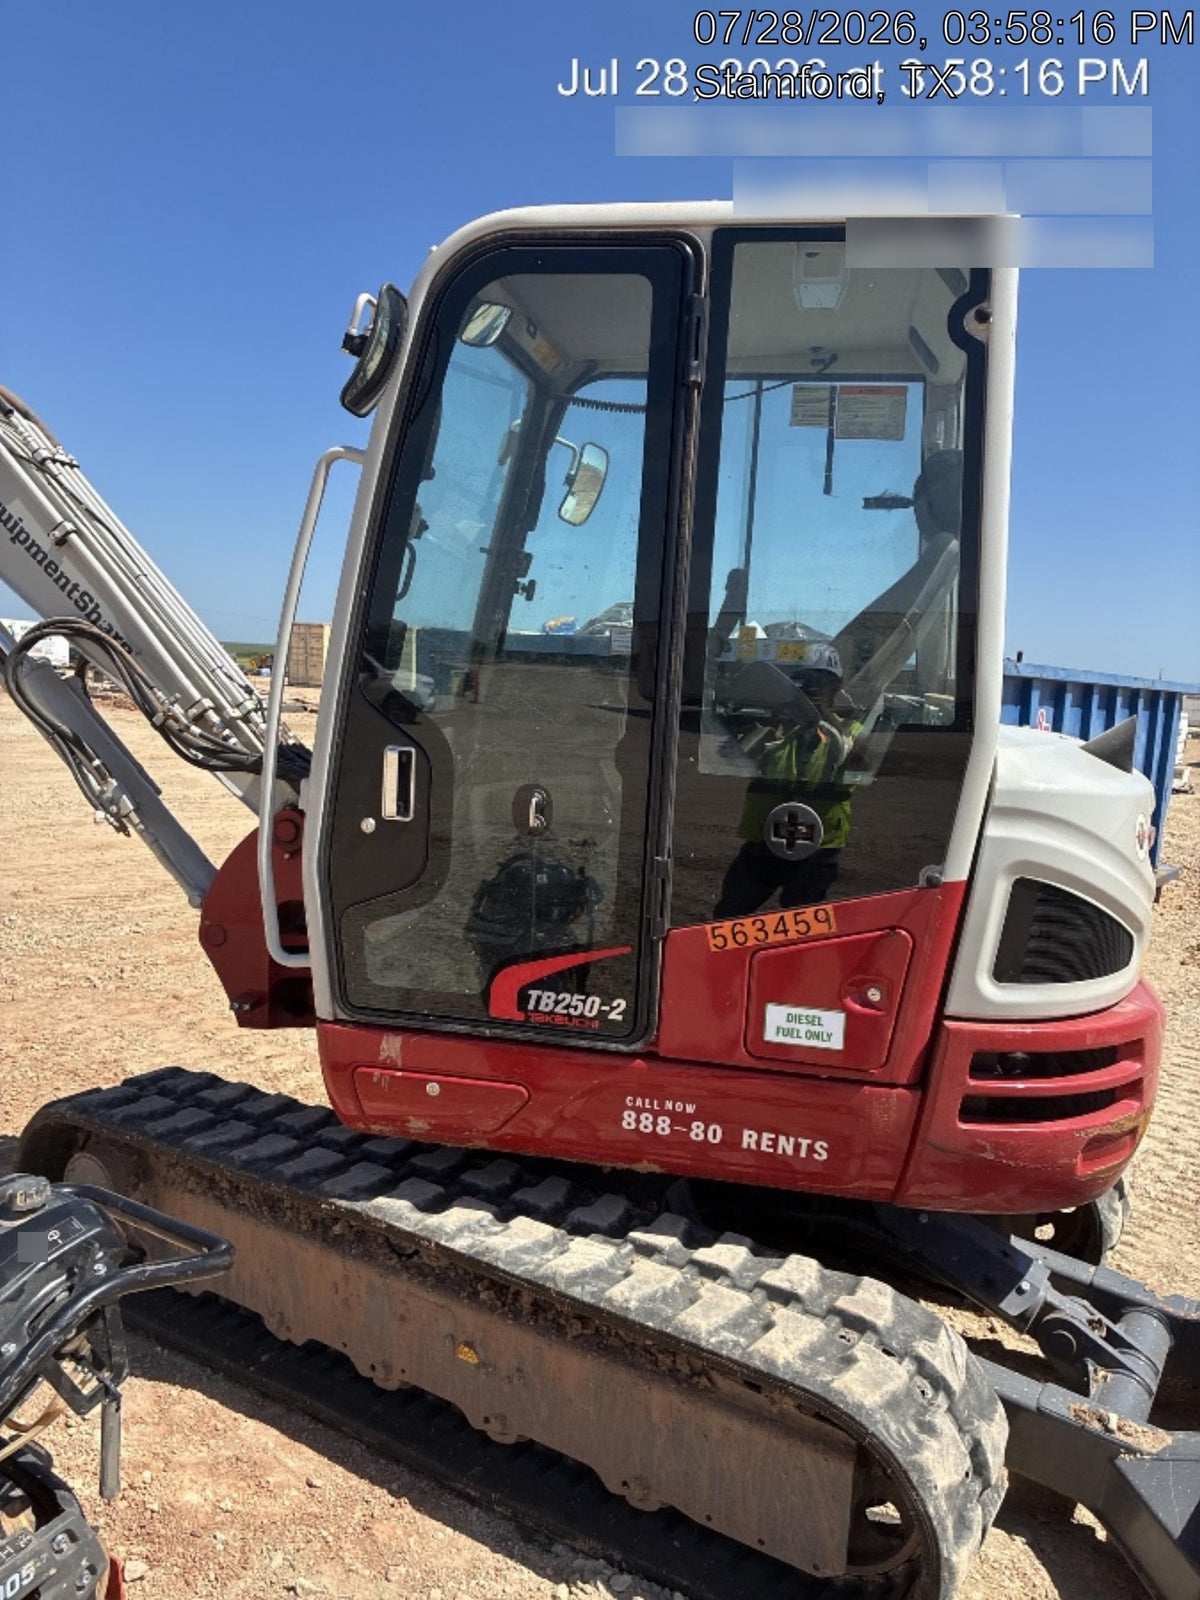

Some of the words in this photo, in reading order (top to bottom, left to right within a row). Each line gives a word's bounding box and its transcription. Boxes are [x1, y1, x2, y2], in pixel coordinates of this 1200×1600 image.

[710, 907, 833, 950] 563459
[527, 989, 627, 1021] TB250-2
[786, 1012, 824, 1027] DIESEL
[776, 1025, 802, 1039] FUEL
[805, 1028, 833, 1043] ONLY
[625, 1096, 661, 1111] CALL
[664, 1100, 697, 1114] NOW
[621, 1110, 723, 1144] 888-80
[741, 1128, 830, 1162] RENTS
